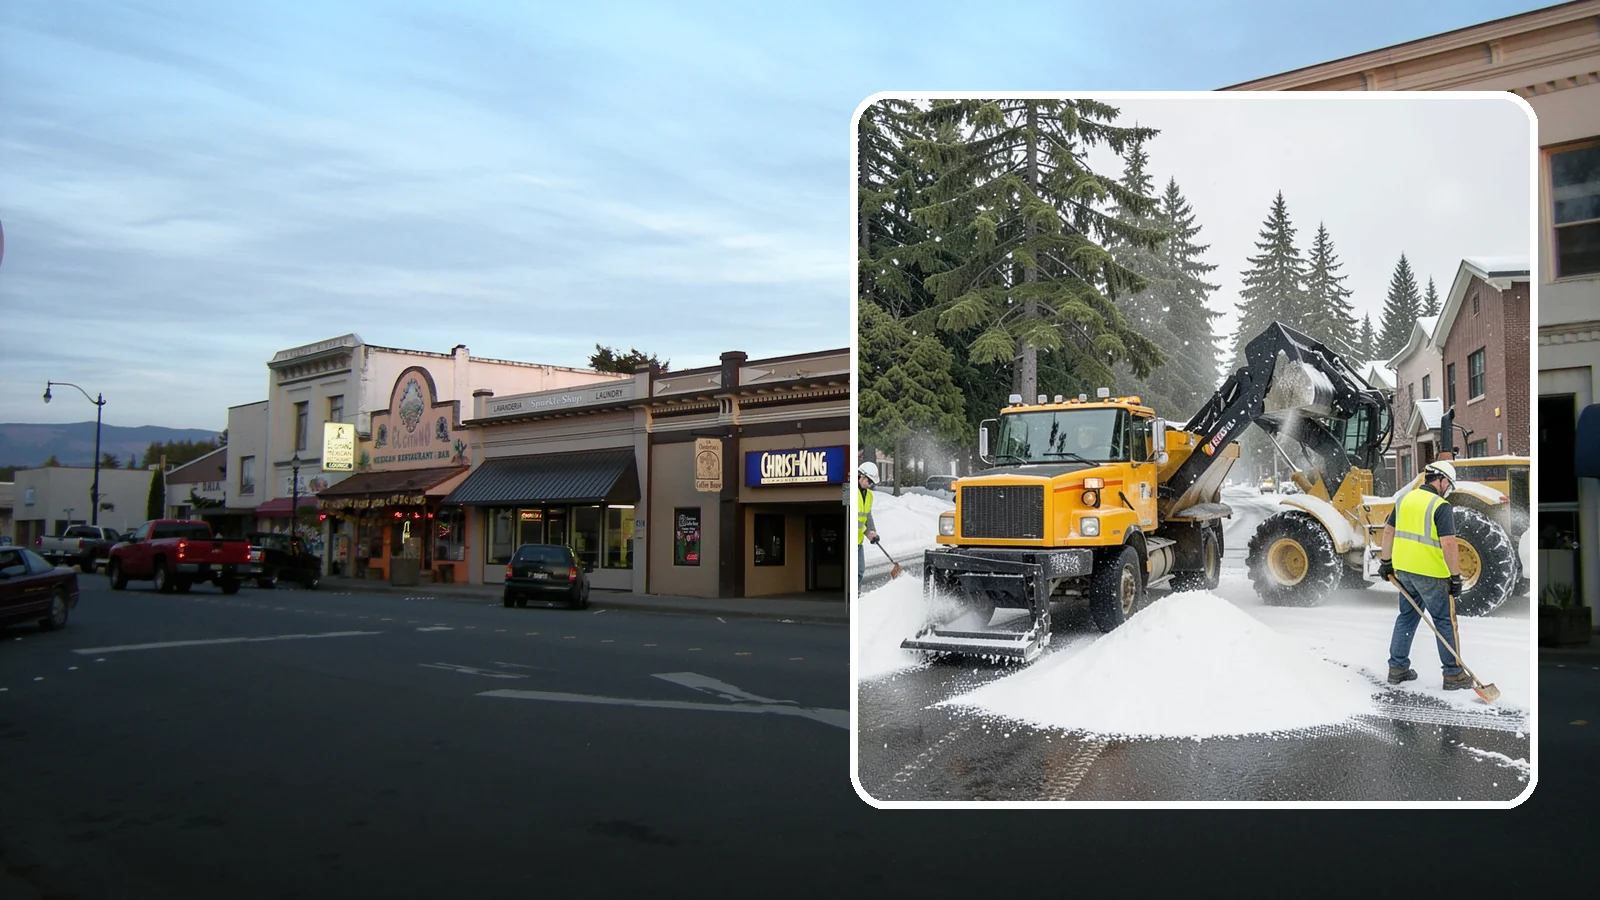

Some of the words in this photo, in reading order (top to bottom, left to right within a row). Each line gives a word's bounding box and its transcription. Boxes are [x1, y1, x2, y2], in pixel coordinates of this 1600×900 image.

[562, 394, 582, 405] Shop
[595, 389, 623, 400] LAUNDRY
[493, 402, 522, 413] LAVANDERIA
[373, 455, 396, 464] MEXICAN
[398, 451, 433, 462] RESTAURANT
[438, 450, 450, 459] BAR
[760, 452, 797, 478] CHRIST
[799, 450, 828, 477] KING
[697, 480, 710, 489] Coffee
[710, 480, 722, 489] House
